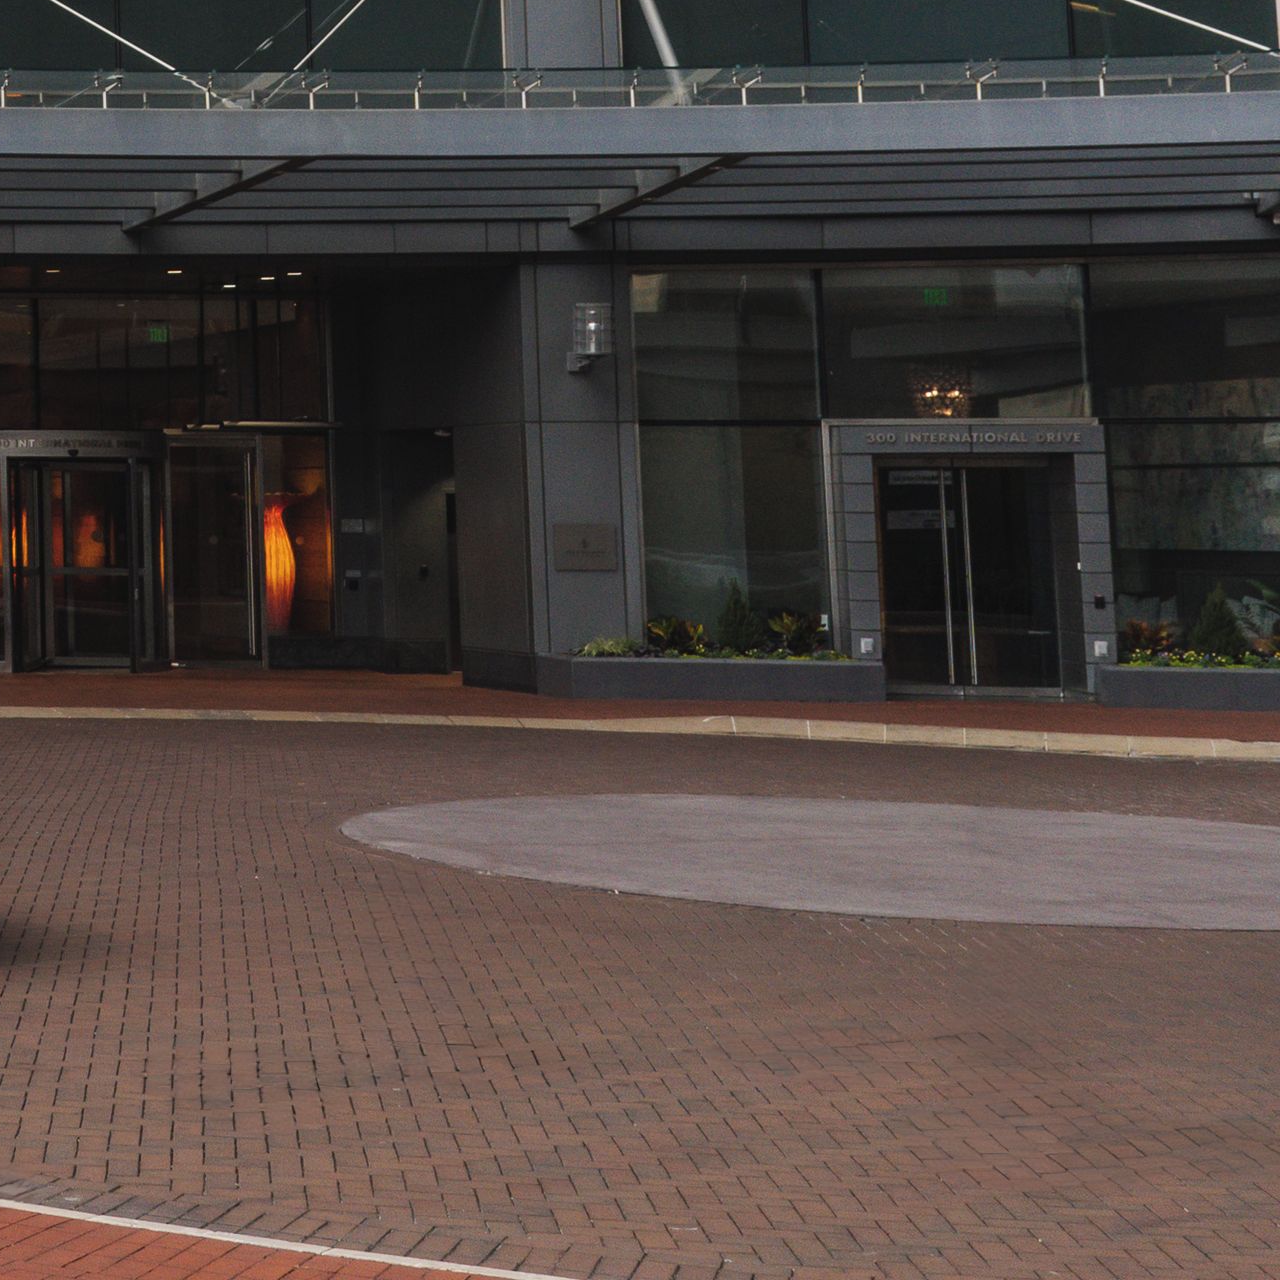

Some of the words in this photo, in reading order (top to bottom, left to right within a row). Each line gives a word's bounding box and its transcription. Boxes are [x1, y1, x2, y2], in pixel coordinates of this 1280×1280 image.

[865, 431, 896, 444] 300
[904, 431, 1028, 443] INTERNATIONAL
[1036, 431, 1081, 443] DRIVE
[16, 439, 113, 449] INTNATIONAL
